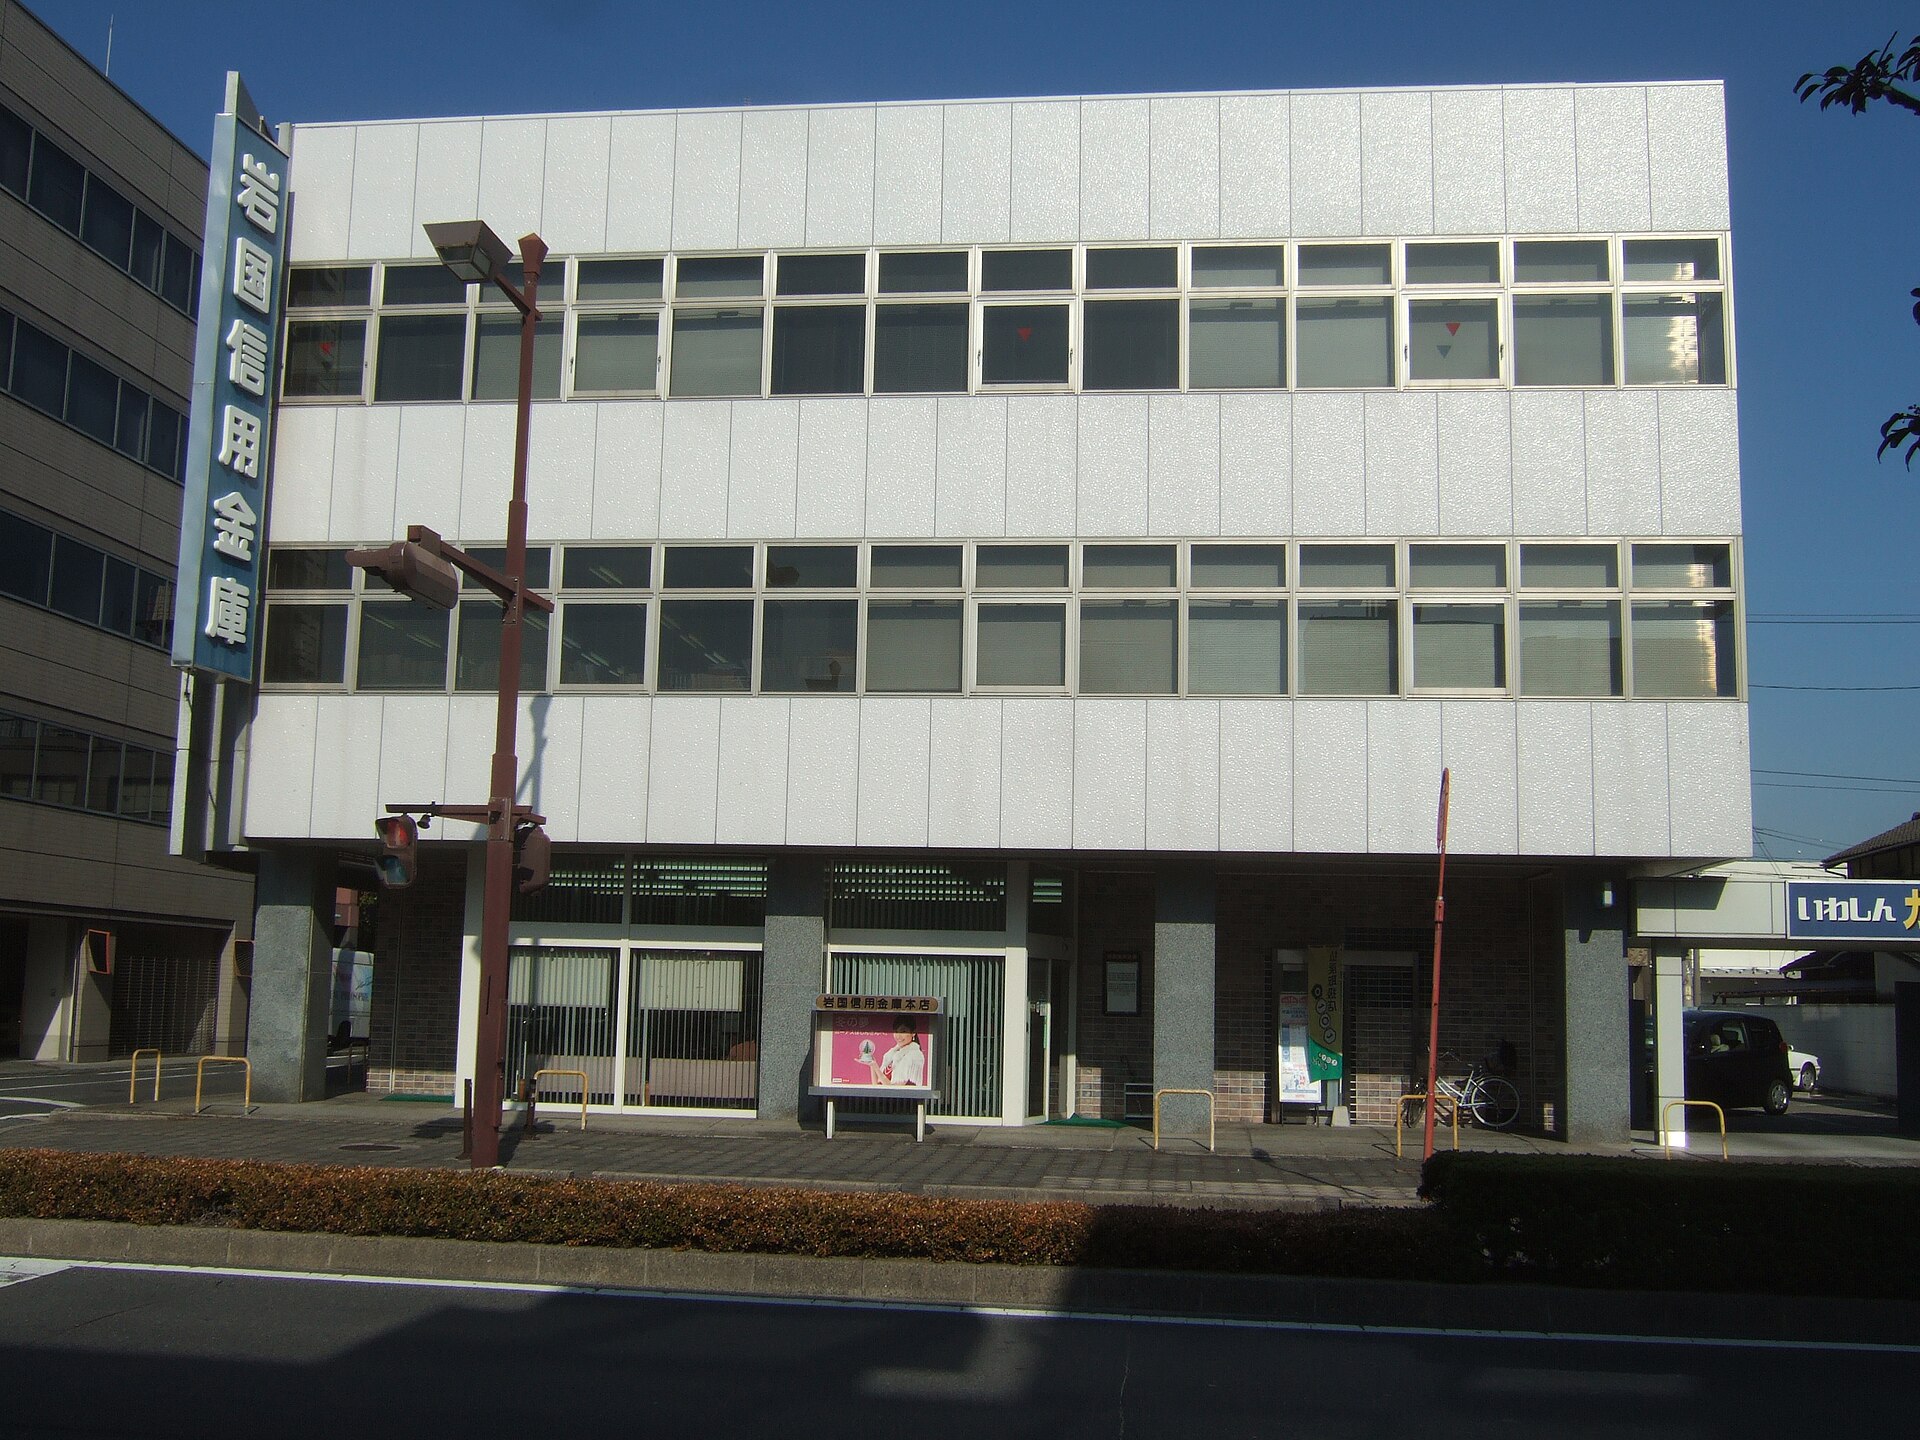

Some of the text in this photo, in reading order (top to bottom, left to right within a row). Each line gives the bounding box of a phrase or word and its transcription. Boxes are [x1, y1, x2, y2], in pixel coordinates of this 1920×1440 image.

[204, 153, 280, 646] 岩国信用金庫
[1797, 897, 1897, 922] いわしん
[823, 996, 931, 1010] 岩国信用金庫本店
